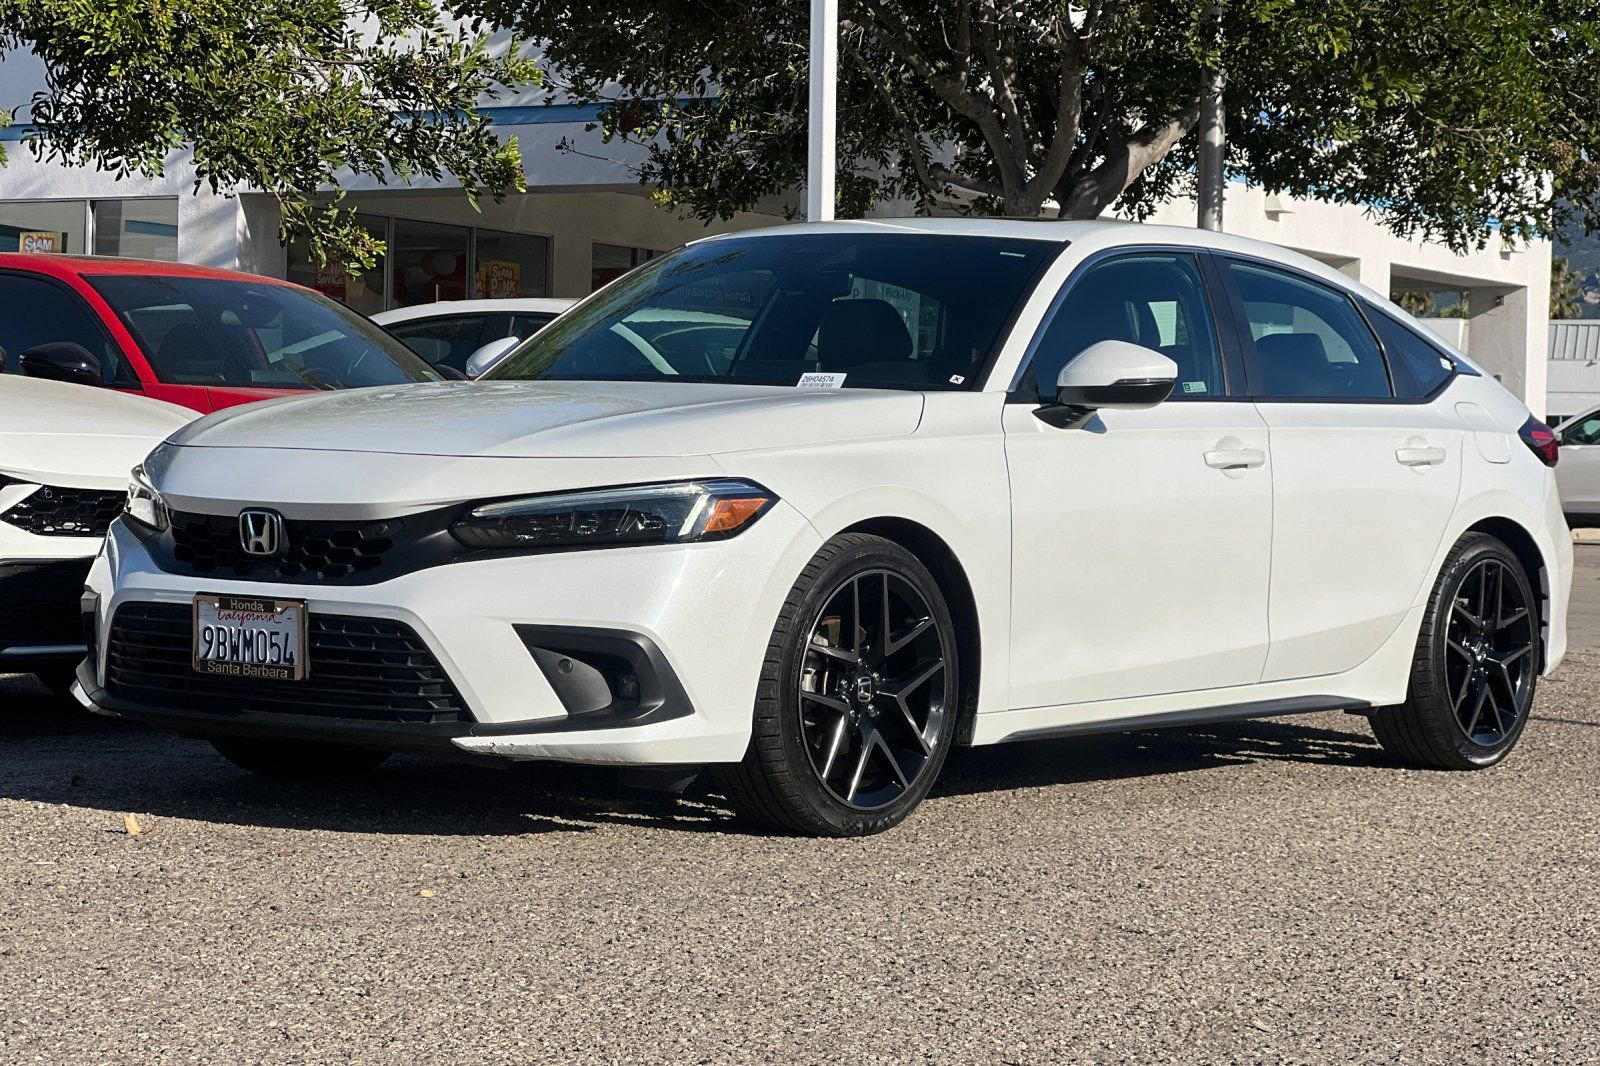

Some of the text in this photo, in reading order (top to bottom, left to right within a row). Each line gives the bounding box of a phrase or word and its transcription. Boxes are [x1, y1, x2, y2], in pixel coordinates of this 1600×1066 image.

[25, 237, 53, 253] SLAM
[230, 599, 264, 611] Honda
[217, 609, 283, 627] California
[203, 626, 295, 666] 9BWM054
[207, 660, 288, 678] Santa Barbara
